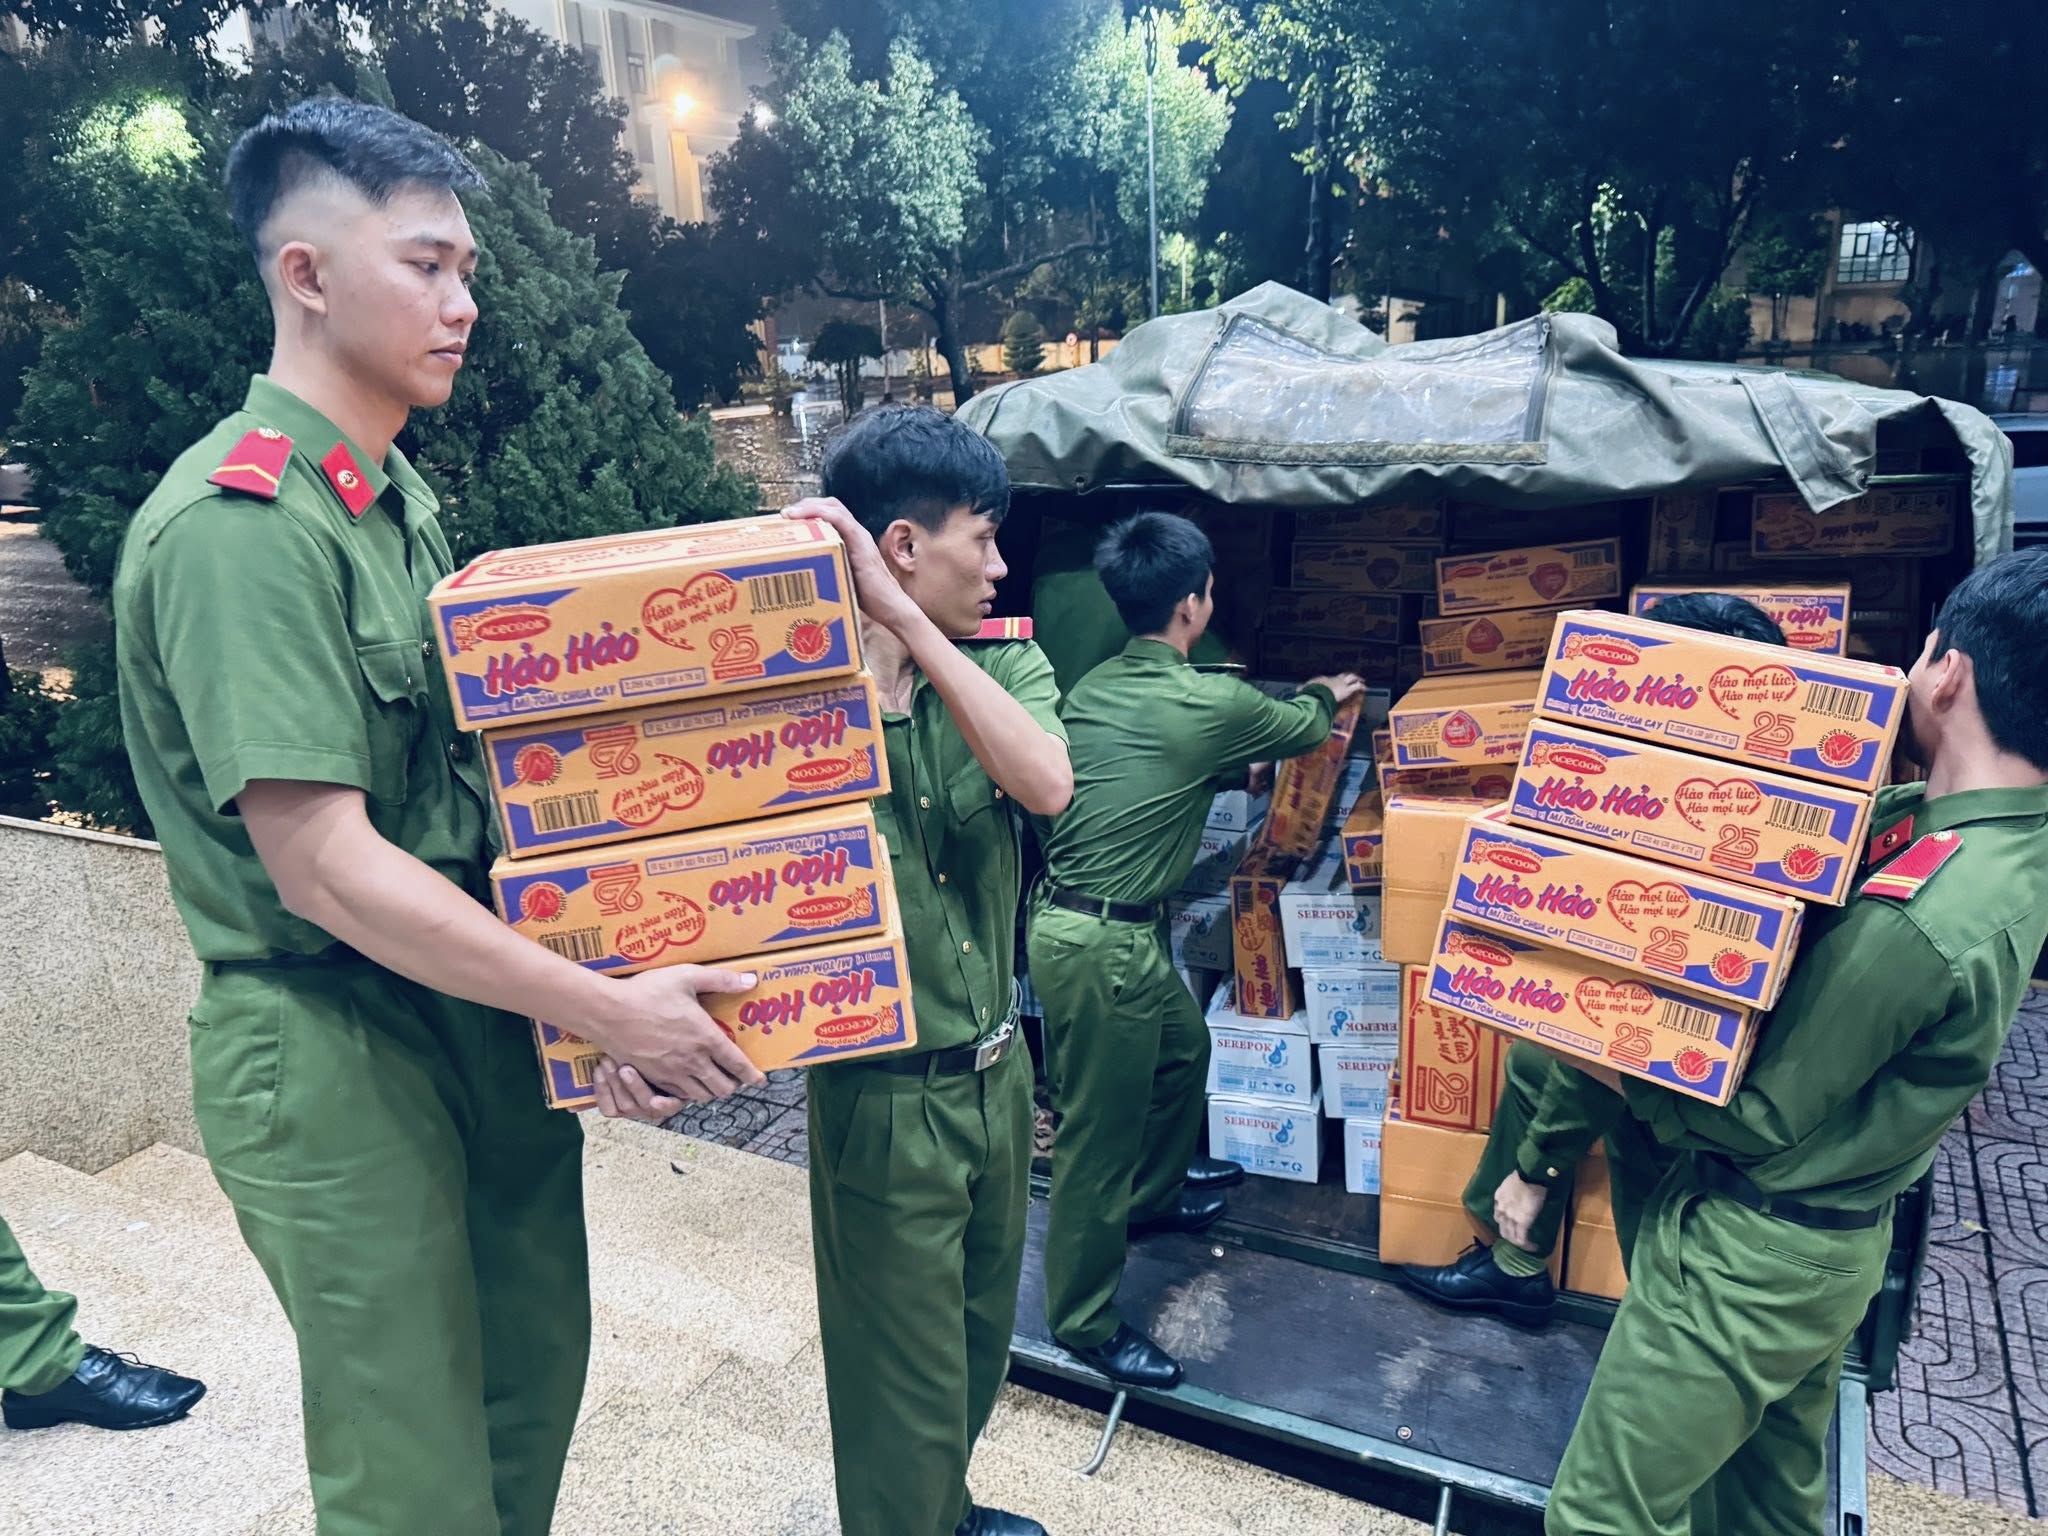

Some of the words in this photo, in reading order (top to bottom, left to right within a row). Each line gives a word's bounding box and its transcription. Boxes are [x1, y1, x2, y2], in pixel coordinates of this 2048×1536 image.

[1788, 607, 1829, 630] Hảo
[483, 642, 559, 695] Hảo
[563, 621, 639, 673] Hảo
[709, 623, 758, 668] 25
[1567, 667, 1630, 702] Hảo
[1633, 674, 1697, 709] Hảo
[780, 709, 847, 757] Hảo
[1746, 711, 1796, 748] 25
[589, 736, 639, 780] 25
[706, 730, 776, 778] Hảo
[1535, 775, 1597, 811] Hảo
[1599, 784, 1663, 820] Hảo
[1711, 824, 1760, 860] 25
[708, 868, 777, 915] Hảo
[781, 848, 848, 895] Hảo
[593, 874, 642, 916] 25
[1297, 909, 1355, 919] SEREPOK
[1474, 873, 1533, 908] Hảo
[1536, 883, 1596, 919] Hảo
[1643, 926, 1689, 963] 25
[762, 968, 781, 981] CAY
[810, 970, 874, 1015] Hảo
[1449, 964, 1505, 1000] Hảo
[1507, 976, 1565, 1013] Hảo
[739, 989, 805, 1034] Hảo
[1345, 1022, 1397, 1032] EREPOK
[1217, 1038, 1272, 1052] SEREPOK
[1609, 1022, 1653, 1058] 25
[1337, 1061, 1390, 1072] SEREPO
[1428, 1067, 1469, 1116] 25
[1224, 1115, 1279, 1130] SEREPOK
